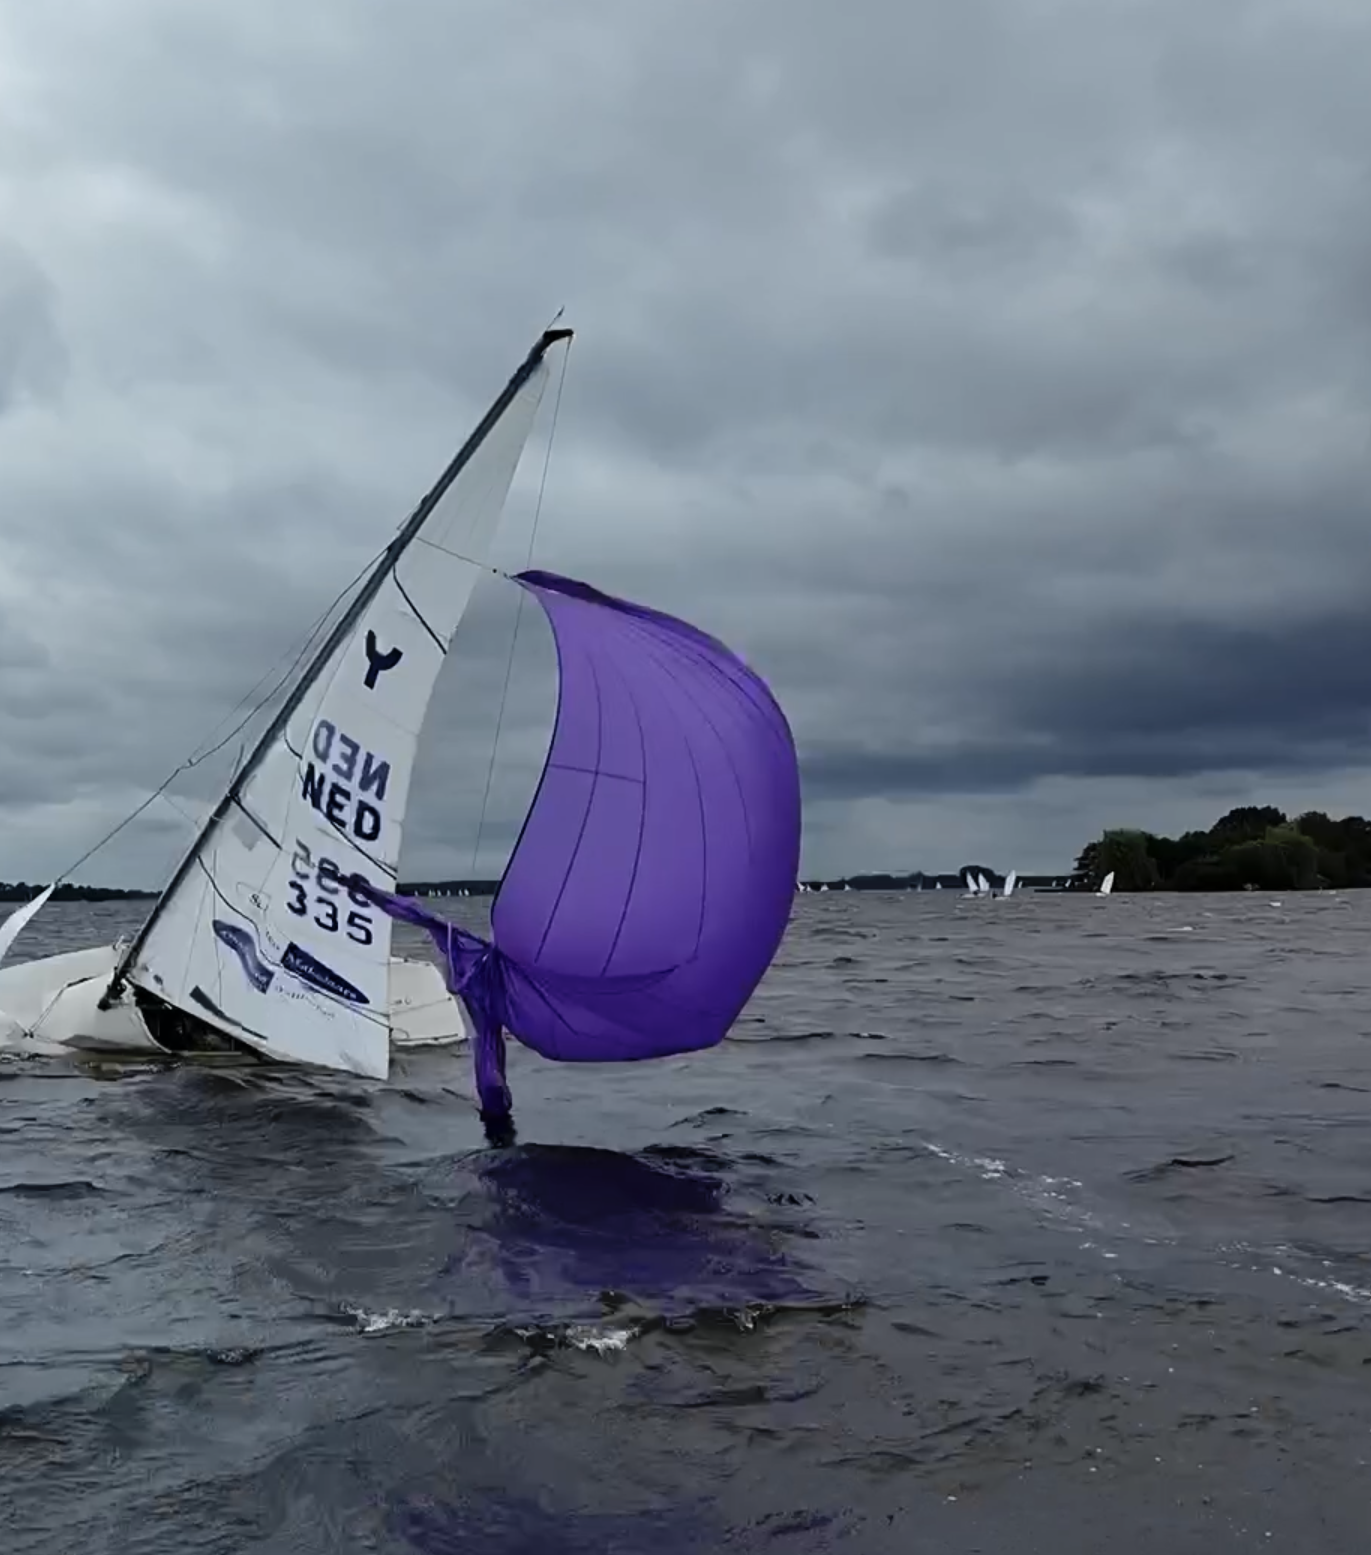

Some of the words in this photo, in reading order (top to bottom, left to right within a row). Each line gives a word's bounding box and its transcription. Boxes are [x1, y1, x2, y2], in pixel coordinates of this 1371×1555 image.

[363, 629, 404, 690] Y
[302, 761, 381, 841] NED
[286, 880, 373, 946] 335
